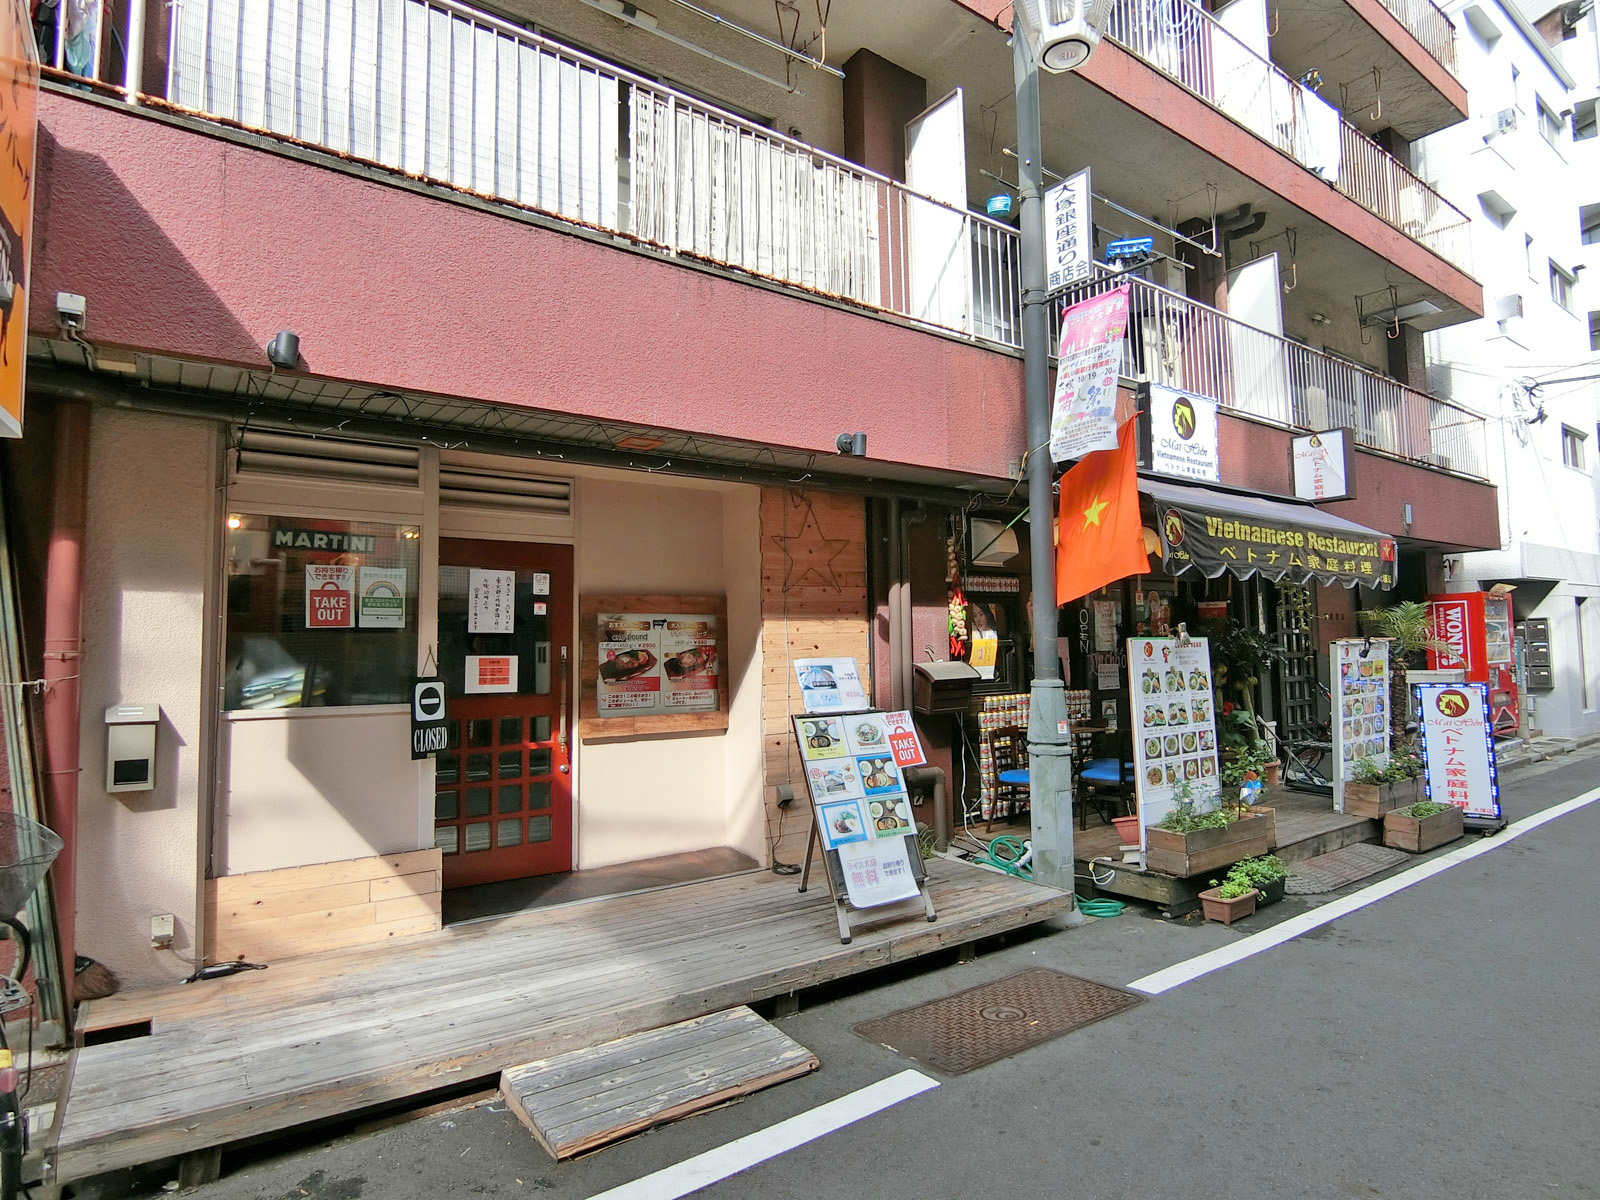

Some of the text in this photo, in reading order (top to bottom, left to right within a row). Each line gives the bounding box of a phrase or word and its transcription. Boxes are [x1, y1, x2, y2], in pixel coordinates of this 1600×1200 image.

[1054, 182, 1078, 267] 大塚銀座通り
[1049, 260, 1088, 288] 商店会
[1161, 438, 1182, 451] Mai
[1156, 449, 1214, 468] Vietnamese Restaurant
[275, 530, 375, 552] MARTINI
[1205, 515, 1379, 558] Vietnamese Restaurant
[314, 566, 349, 574] お持ち帰り
[1219, 546, 1374, 575] ベトナム家庭料理
[313, 596, 347, 609] TAKE
[317, 608, 344, 620] OUT
[1080, 609, 1089, 654] OPEN
[1446, 606, 1465, 666] WONDA
[885, 712, 906, 720] お持ち帰り
[1426, 718, 1453, 726] Mai
[414, 726, 448, 752] CLOSED
[892, 738, 916, 750] TAKE
[898, 749, 916, 761] OUT
[882, 860, 905, 869] お持ち帰り
[851, 868, 879, 889] 無料
